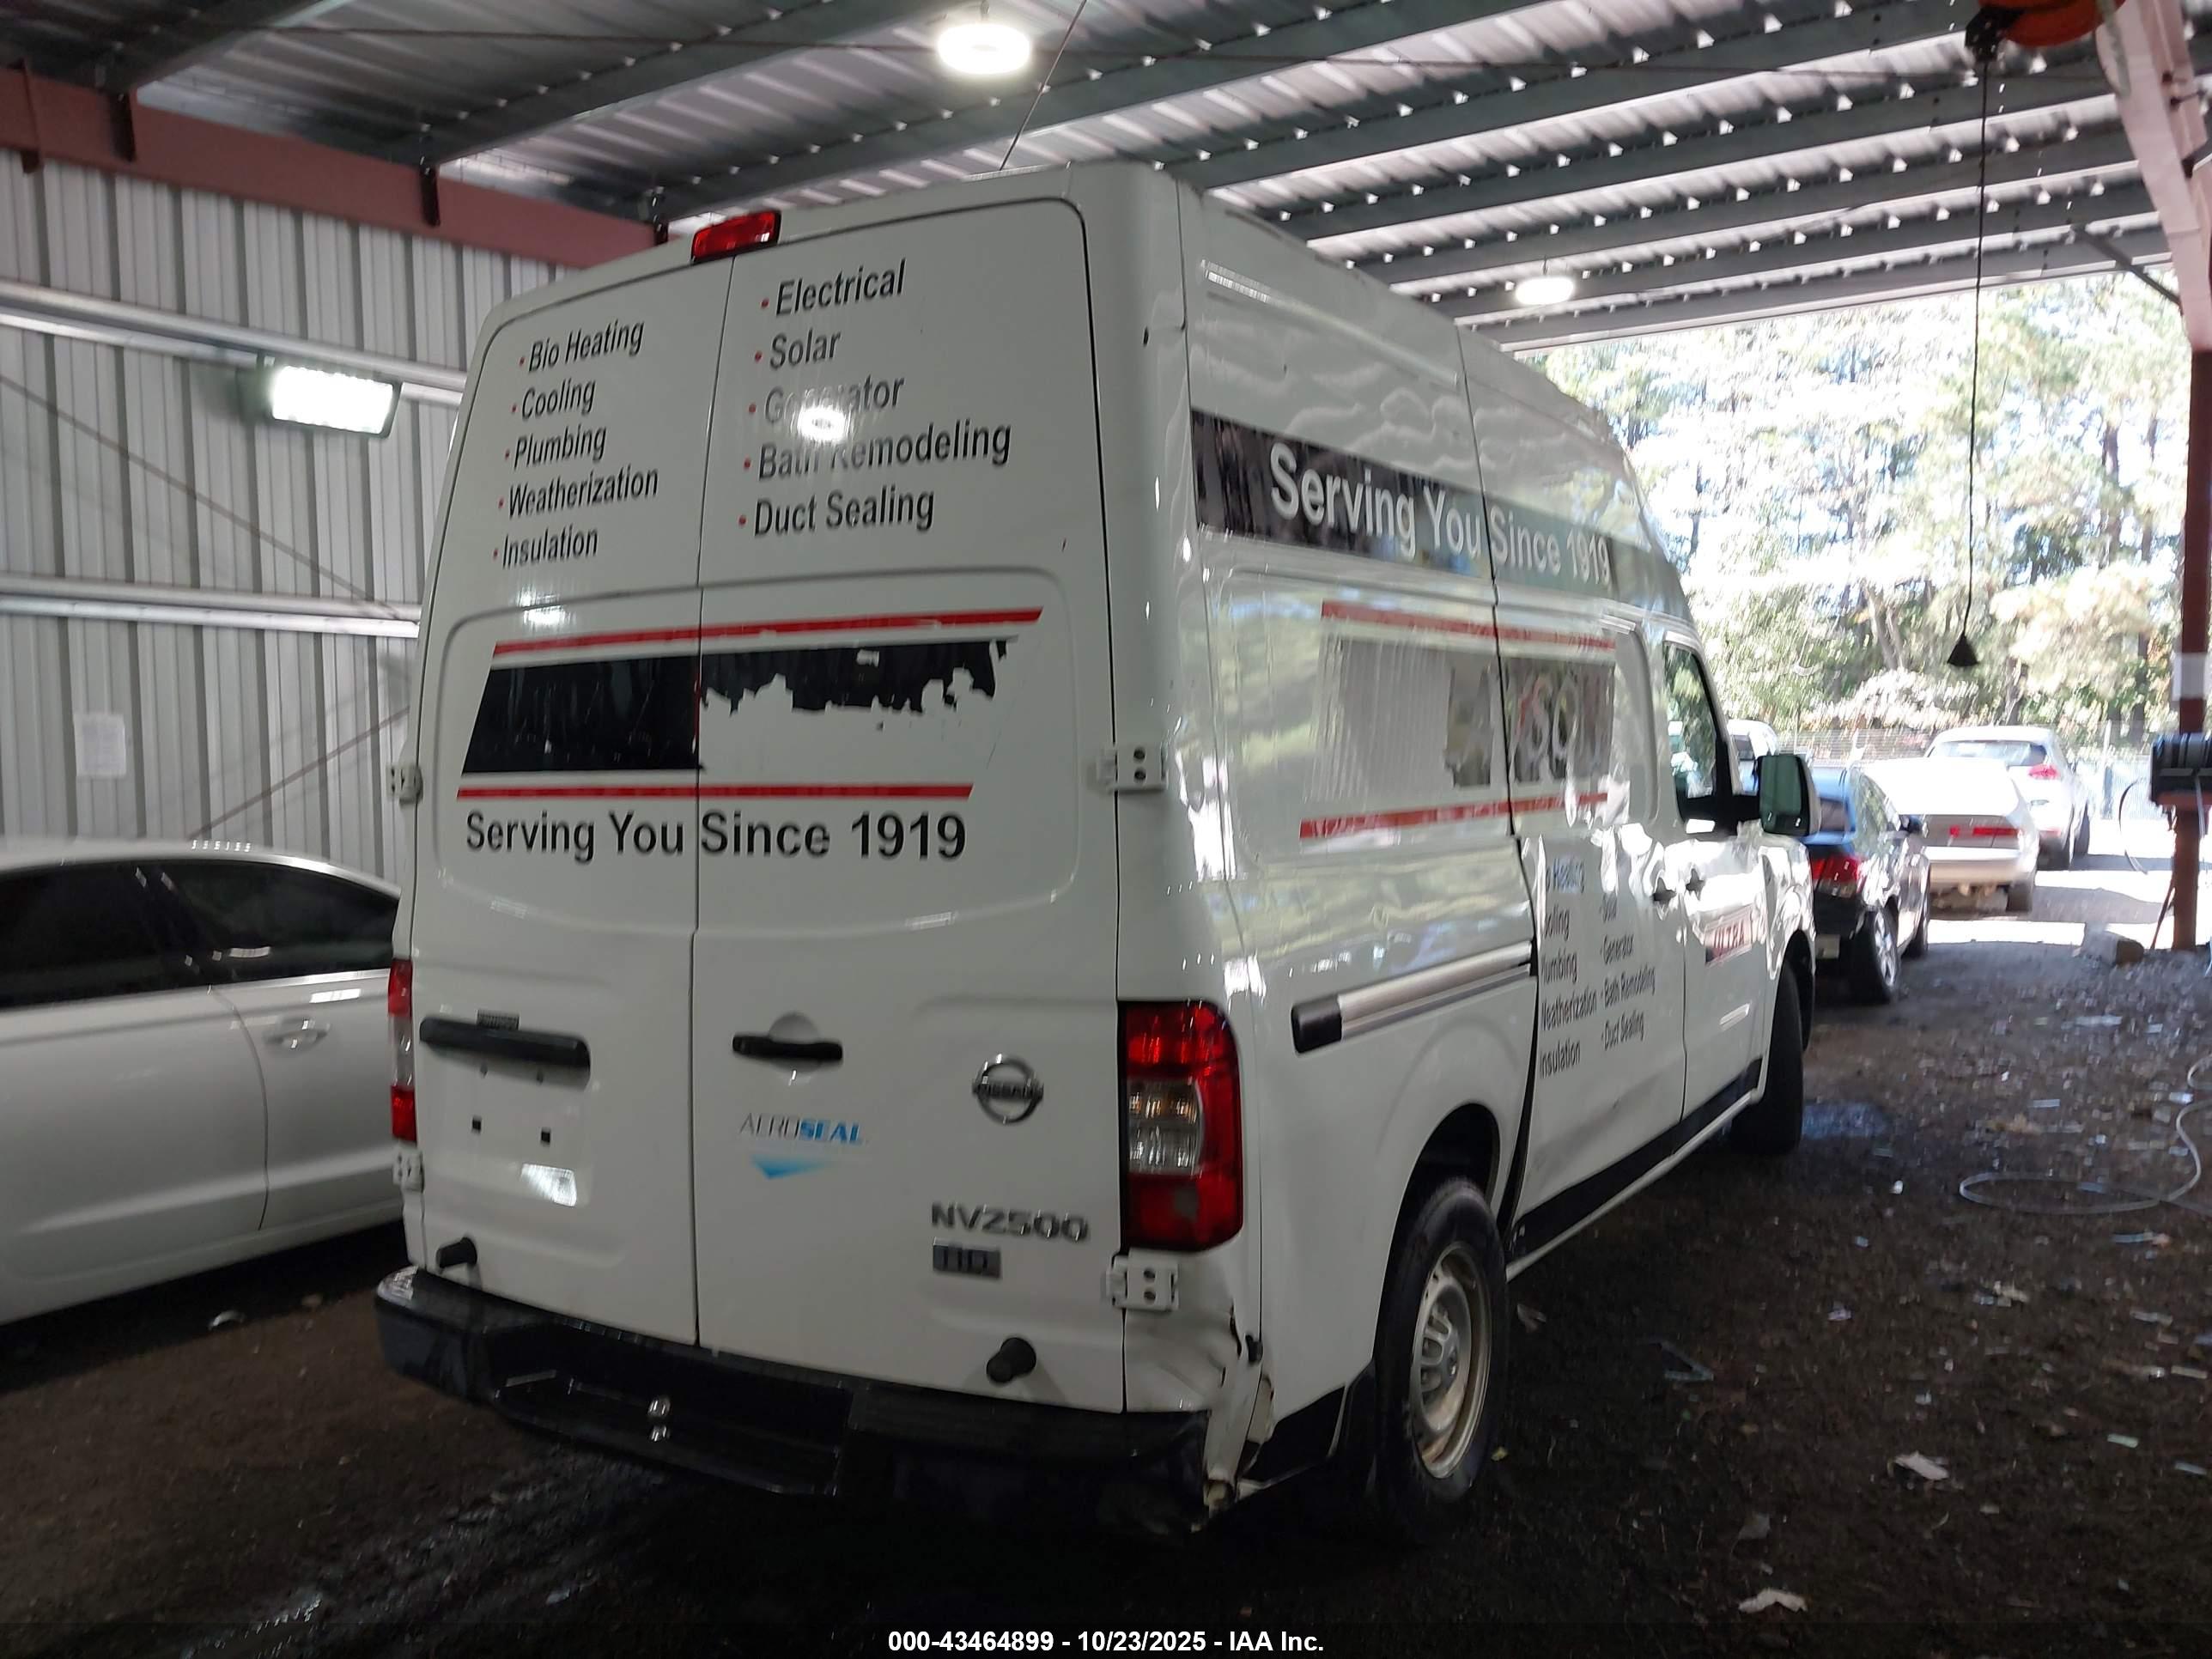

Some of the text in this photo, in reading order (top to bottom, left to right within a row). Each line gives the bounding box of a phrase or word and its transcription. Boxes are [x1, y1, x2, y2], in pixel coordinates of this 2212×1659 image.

[775, 259, 906, 316] Electrical
[529, 319, 644, 372] Bio Heating
[770, 330, 840, 369] Solar
[522, 379, 595, 420] Cooling
[515, 426, 607, 468] Plumbing
[509, 468, 658, 519] Weatherization
[755, 485, 934, 537] Duct Sealing
[1271, 442, 1609, 585] Serving You Since 1919
[503, 527, 598, 568] Insulation
[467, 809, 965, 863] Serving You Since 1919
[1605, 978, 1620, 1008] Bath
[1605, 1009, 1644, 1050] Duct Sealing
[740, 1113, 863, 1146] AEROSEAL
[932, 1201, 1088, 1241] NV2500
